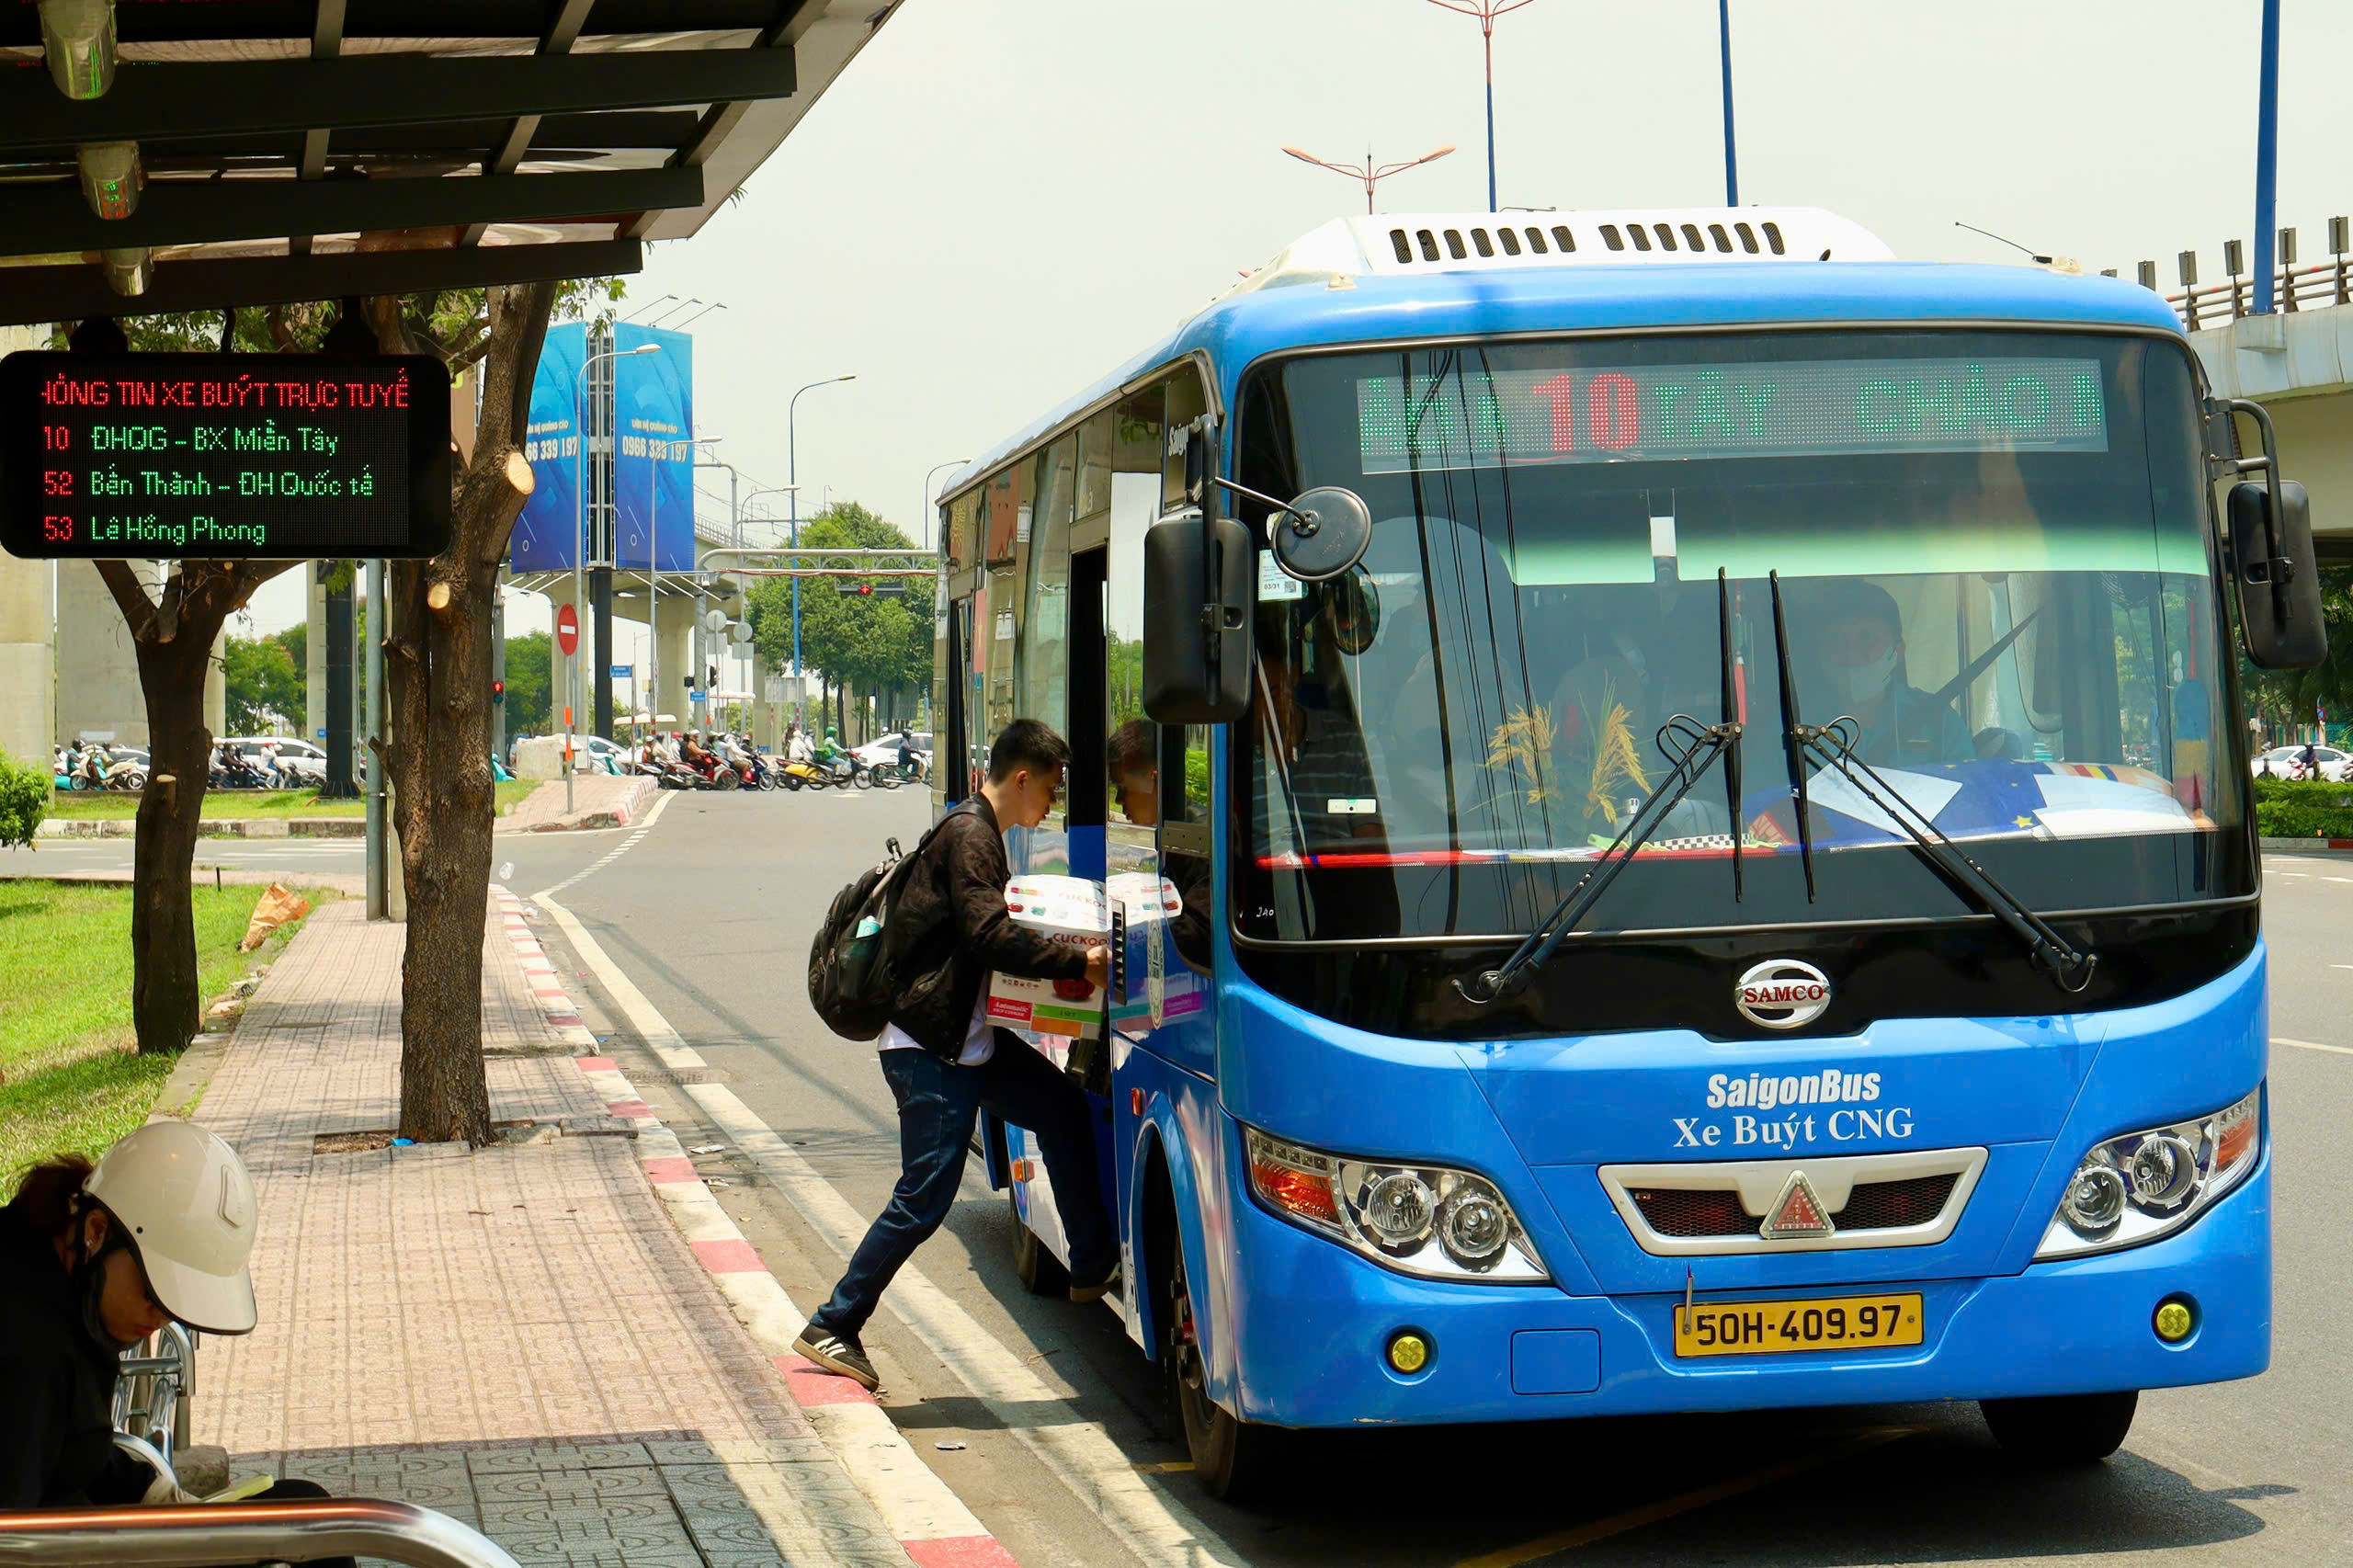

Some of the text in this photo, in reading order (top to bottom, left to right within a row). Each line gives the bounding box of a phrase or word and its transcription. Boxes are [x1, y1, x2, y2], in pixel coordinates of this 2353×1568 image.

[117, 381, 154, 405] TIN
[161, 381, 196, 406] XE
[201, 373, 269, 406] BUÝT
[275, 380, 339, 412] TRỰC
[1530, 373, 1639, 450] 10
[1654, 370, 1776, 438] TÂY
[1856, 365, 2051, 433] CHÀO
[43, 426, 69, 449] 10
[91, 426, 167, 449] ĐHQG
[194, 426, 228, 450] BX
[235, 418, 290, 450] Miền
[297, 426, 338, 457] Tây
[45, 471, 73, 495] 52
[91, 462, 133, 495] Bến
[141, 471, 210, 495] Thành
[238, 471, 274, 495] ĐH
[280, 469, 342, 495] Quốc
[349, 463, 373, 496] tế
[45, 516, 73, 540] 53
[92, 516, 119, 540] Lê
[193, 516, 266, 546] Phong
[1744, 984, 1824, 1004] SAMCO
[1706, 1069, 1881, 1110] SaigonBus
[1672, 1108, 1915, 1151] Xe Buýt CNG
[1697, 1305, 1902, 1346] 50H-409.97
